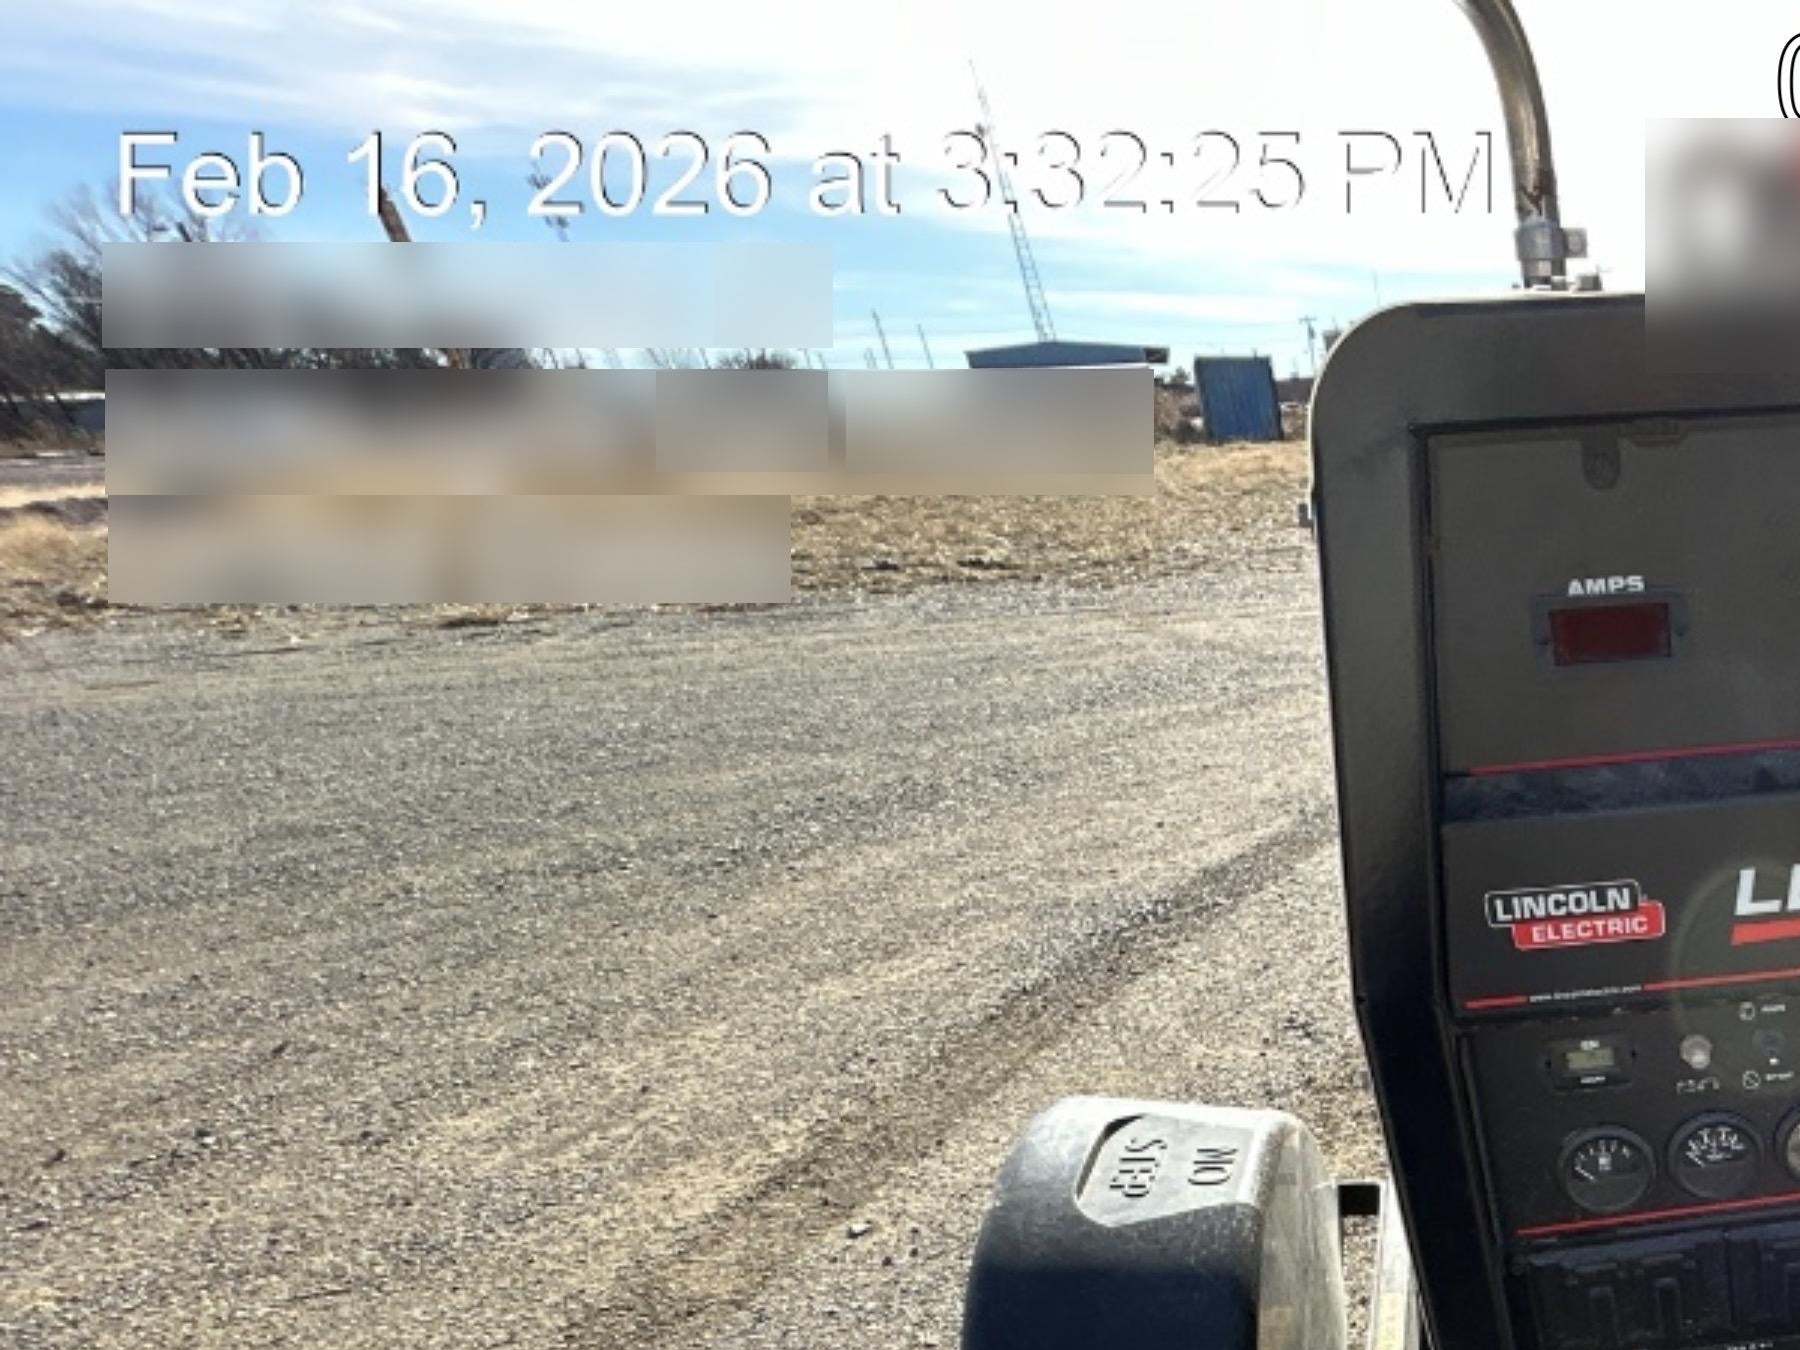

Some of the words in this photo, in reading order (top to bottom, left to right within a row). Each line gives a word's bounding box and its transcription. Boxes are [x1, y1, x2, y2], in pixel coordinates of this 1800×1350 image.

[1567, 575, 1645, 596] AMPS
[1494, 887, 1631, 922] LINCOLN
[1531, 916, 1649, 943] ELECTRIC
[1187, 1148, 1238, 1186] NO
